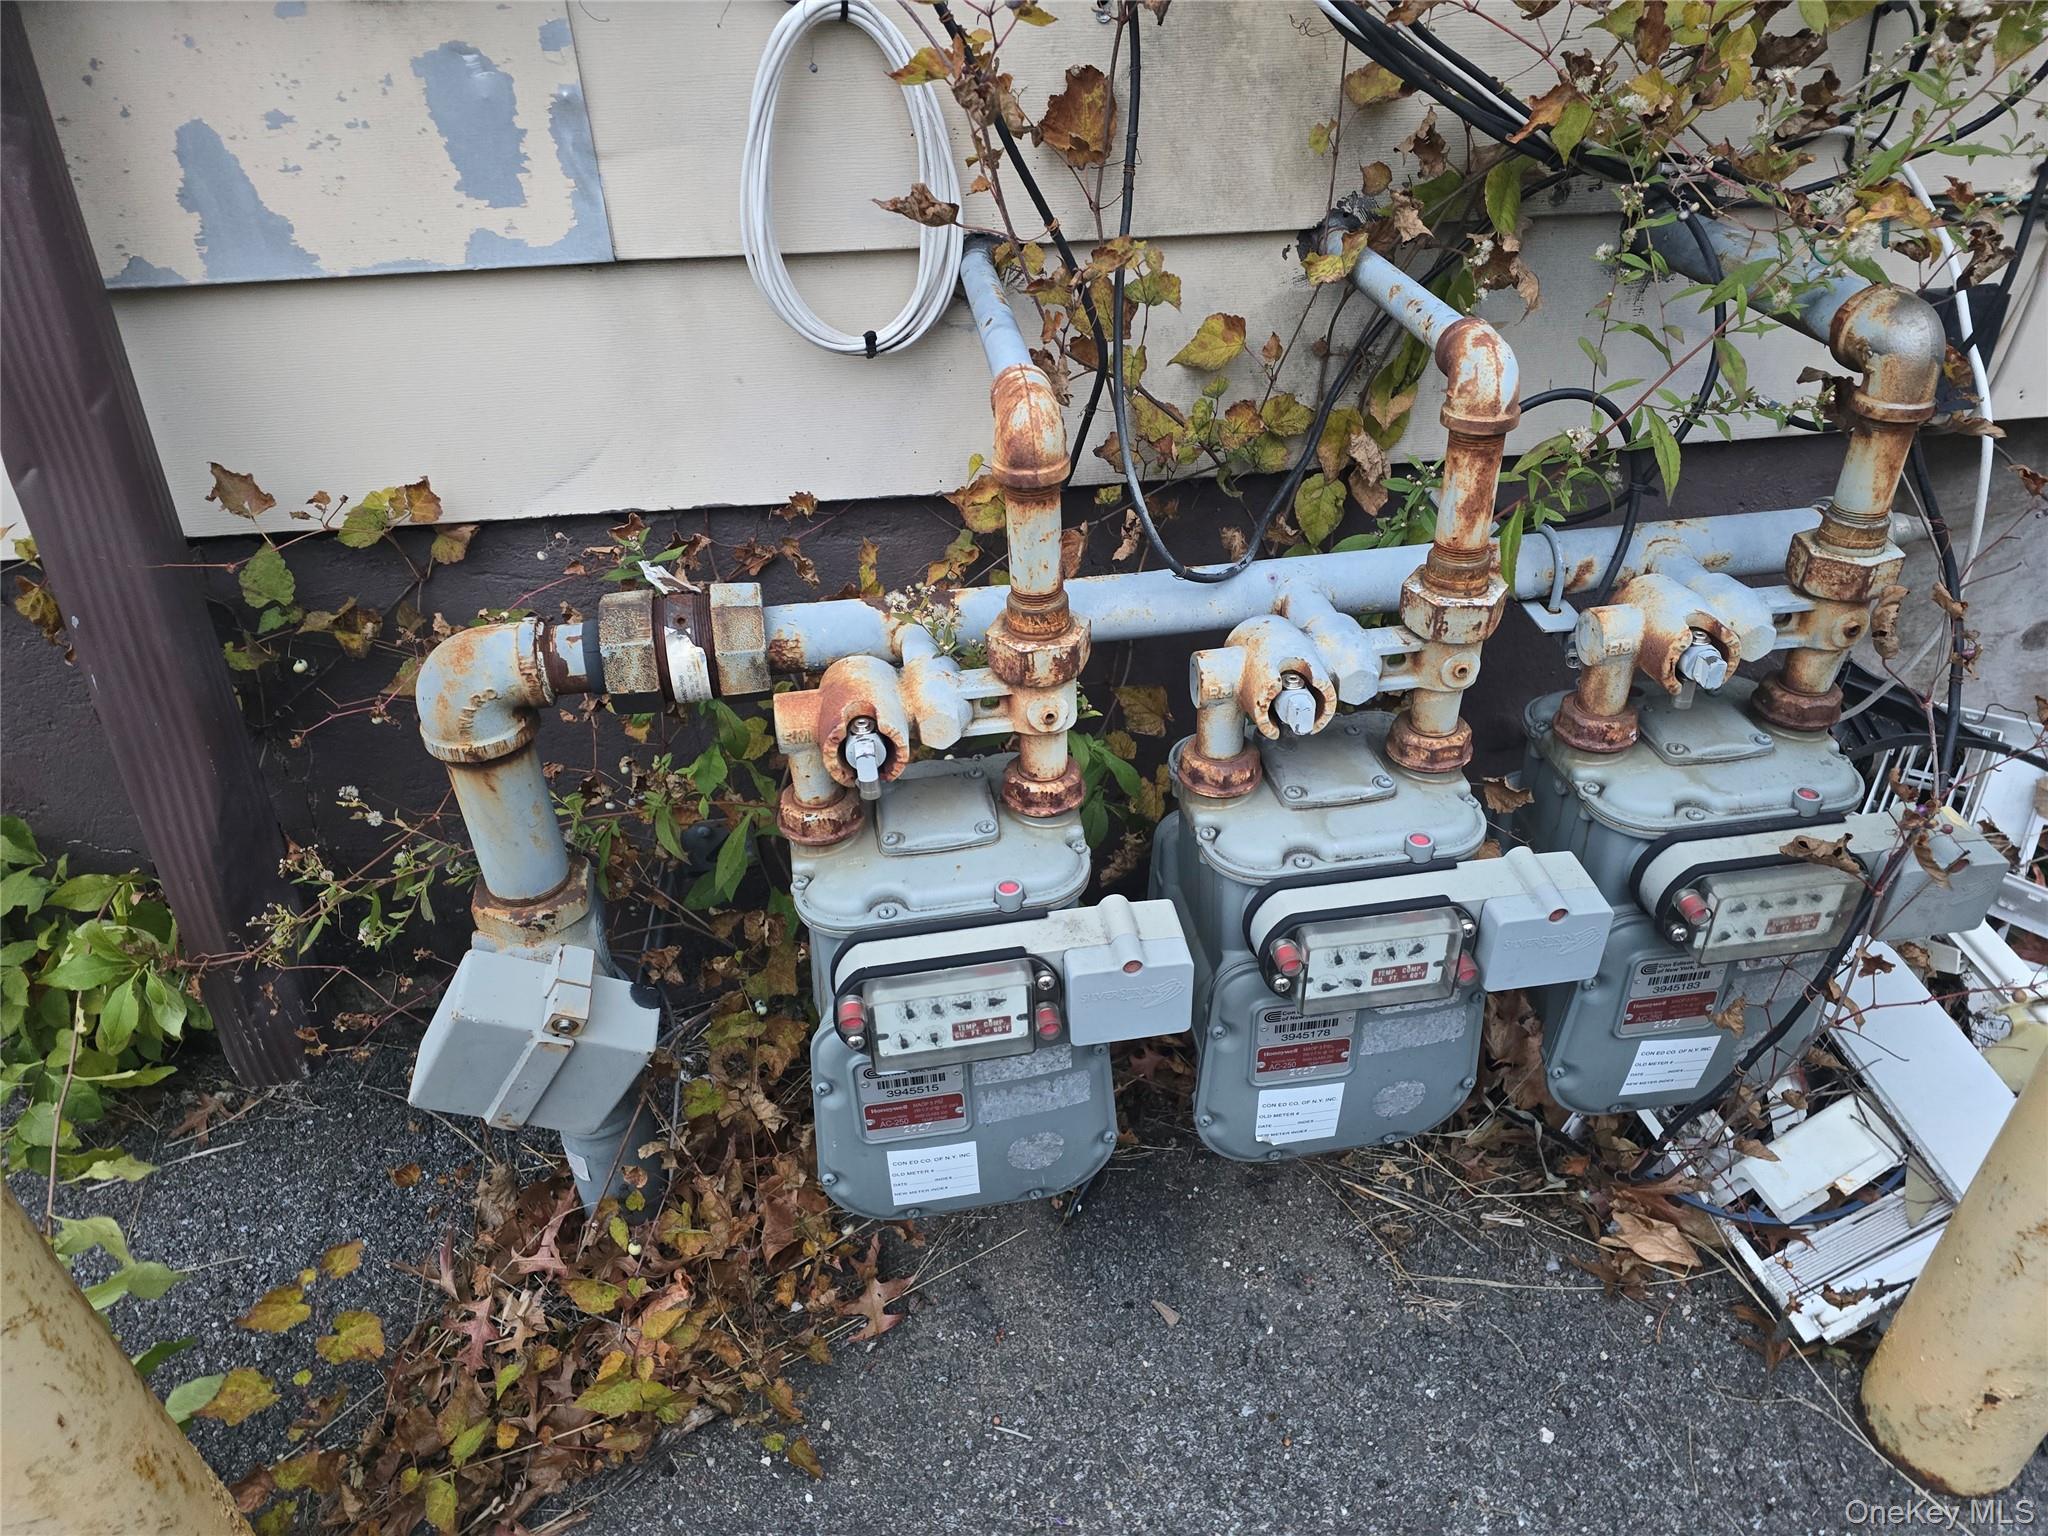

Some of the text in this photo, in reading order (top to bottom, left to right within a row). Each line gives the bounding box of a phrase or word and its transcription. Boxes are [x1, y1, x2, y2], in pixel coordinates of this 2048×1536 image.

[1652, 981, 1701, 994] 3945183
[1281, 1028, 1331, 1041] 3945178
[1264, 1048, 1299, 1057] Honeywell
[1268, 1061, 1297, 1071] AC-250
[886, 1084, 939, 1098] 3945515
[870, 1105, 908, 1114] Honeywell
[880, 1118, 909, 1128] AC-250
[909, 1188, 930, 1196] METER
